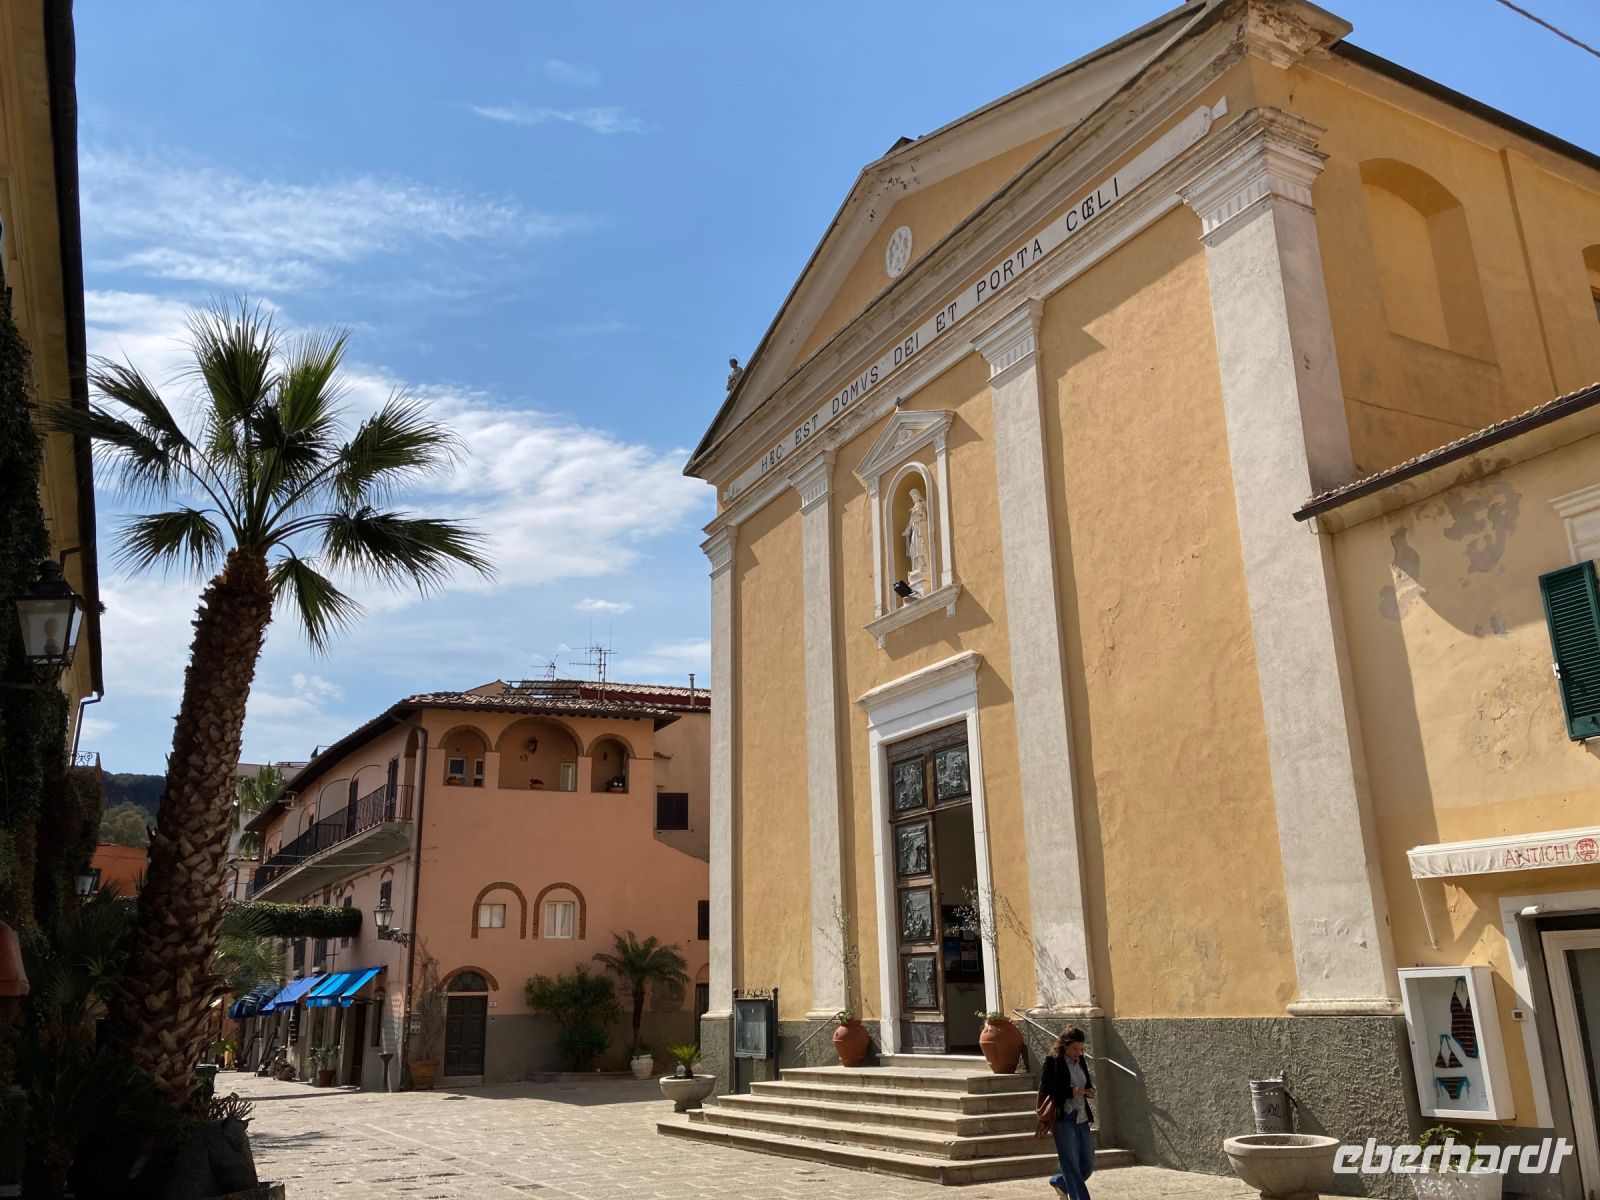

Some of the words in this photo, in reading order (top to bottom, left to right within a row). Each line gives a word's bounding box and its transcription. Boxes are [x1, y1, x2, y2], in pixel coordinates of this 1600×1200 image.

[794, 414, 819, 446] EST
[831, 365, 879, 416] DOMVS
[893, 332, 920, 367] DEI
[936, 302, 957, 333] ET
[976, 238, 1043, 302] PORTA
[1504, 843, 1571, 867] ANTICHI
